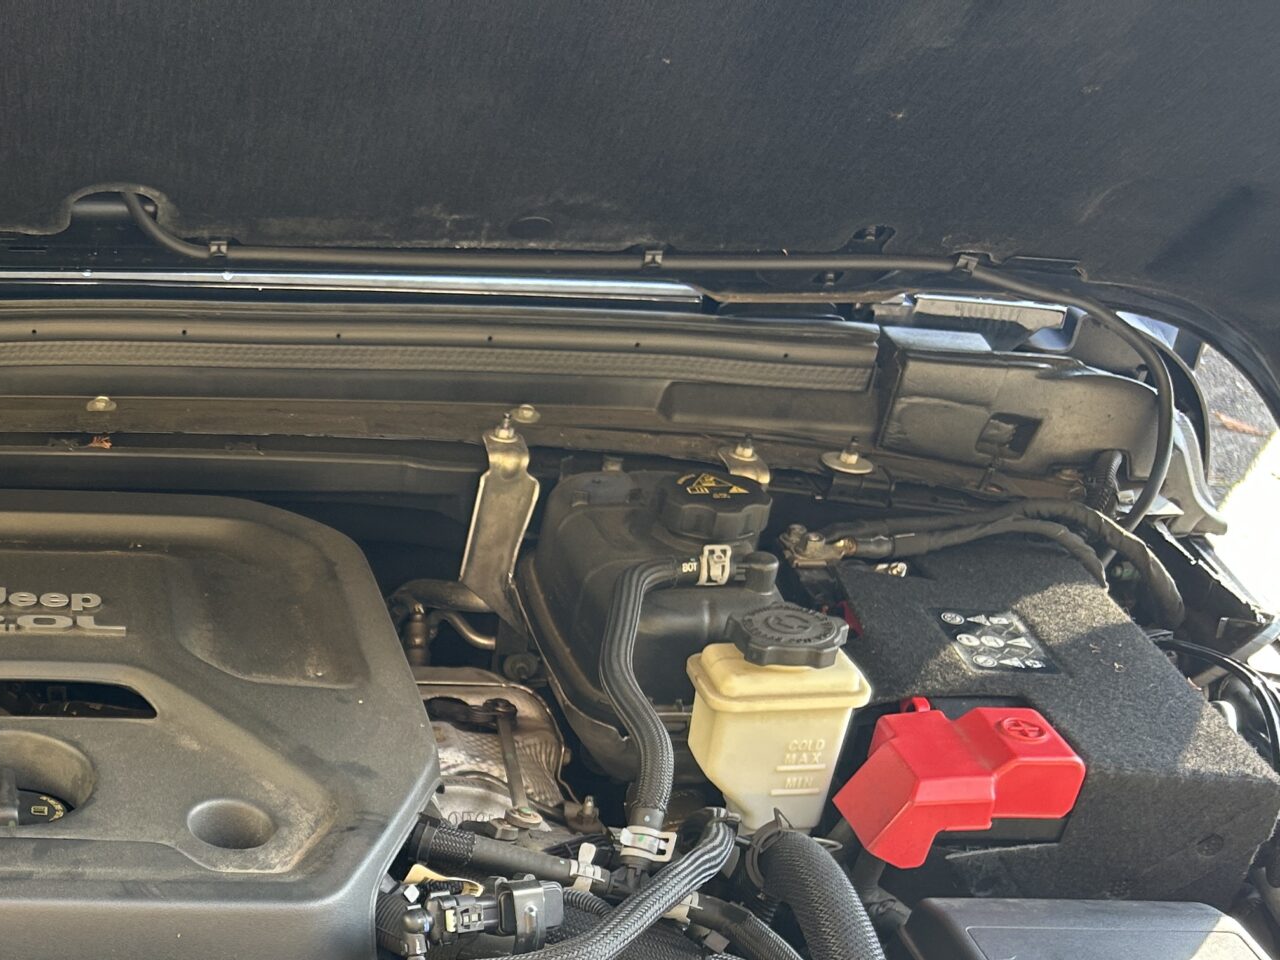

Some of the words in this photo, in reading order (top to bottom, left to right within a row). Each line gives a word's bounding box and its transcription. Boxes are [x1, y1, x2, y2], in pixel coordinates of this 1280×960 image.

[788, 739, 826, 751] COLD
[784, 752, 822, 764] MAX
[785, 777, 814, 789] MIN
